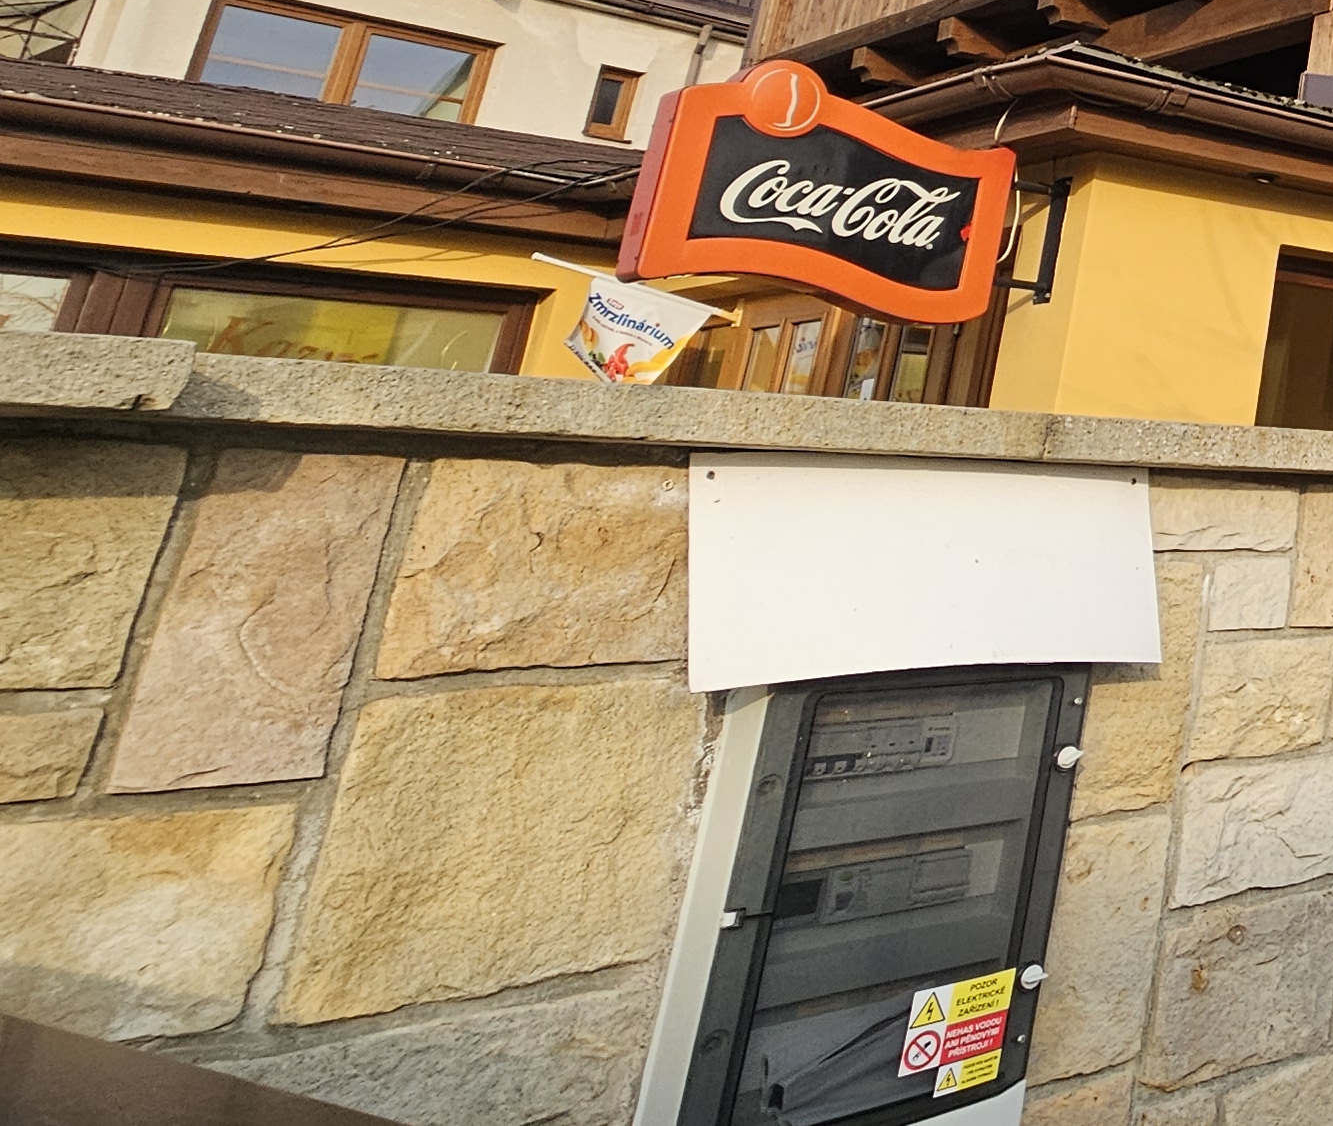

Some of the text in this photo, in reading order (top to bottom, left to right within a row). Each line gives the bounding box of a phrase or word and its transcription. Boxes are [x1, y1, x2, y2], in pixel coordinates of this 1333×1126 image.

[719, 159, 962, 249] Coca-Cola
[588, 292, 675, 350] Zmrzlinárium
[956, 985, 1006, 1006] ELEKTRICKÉ
[970, 978, 998, 992] POZOR
[945, 1016, 1003, 1039] NEHAS VODOU
[944, 1038, 960, 1049] ANI
